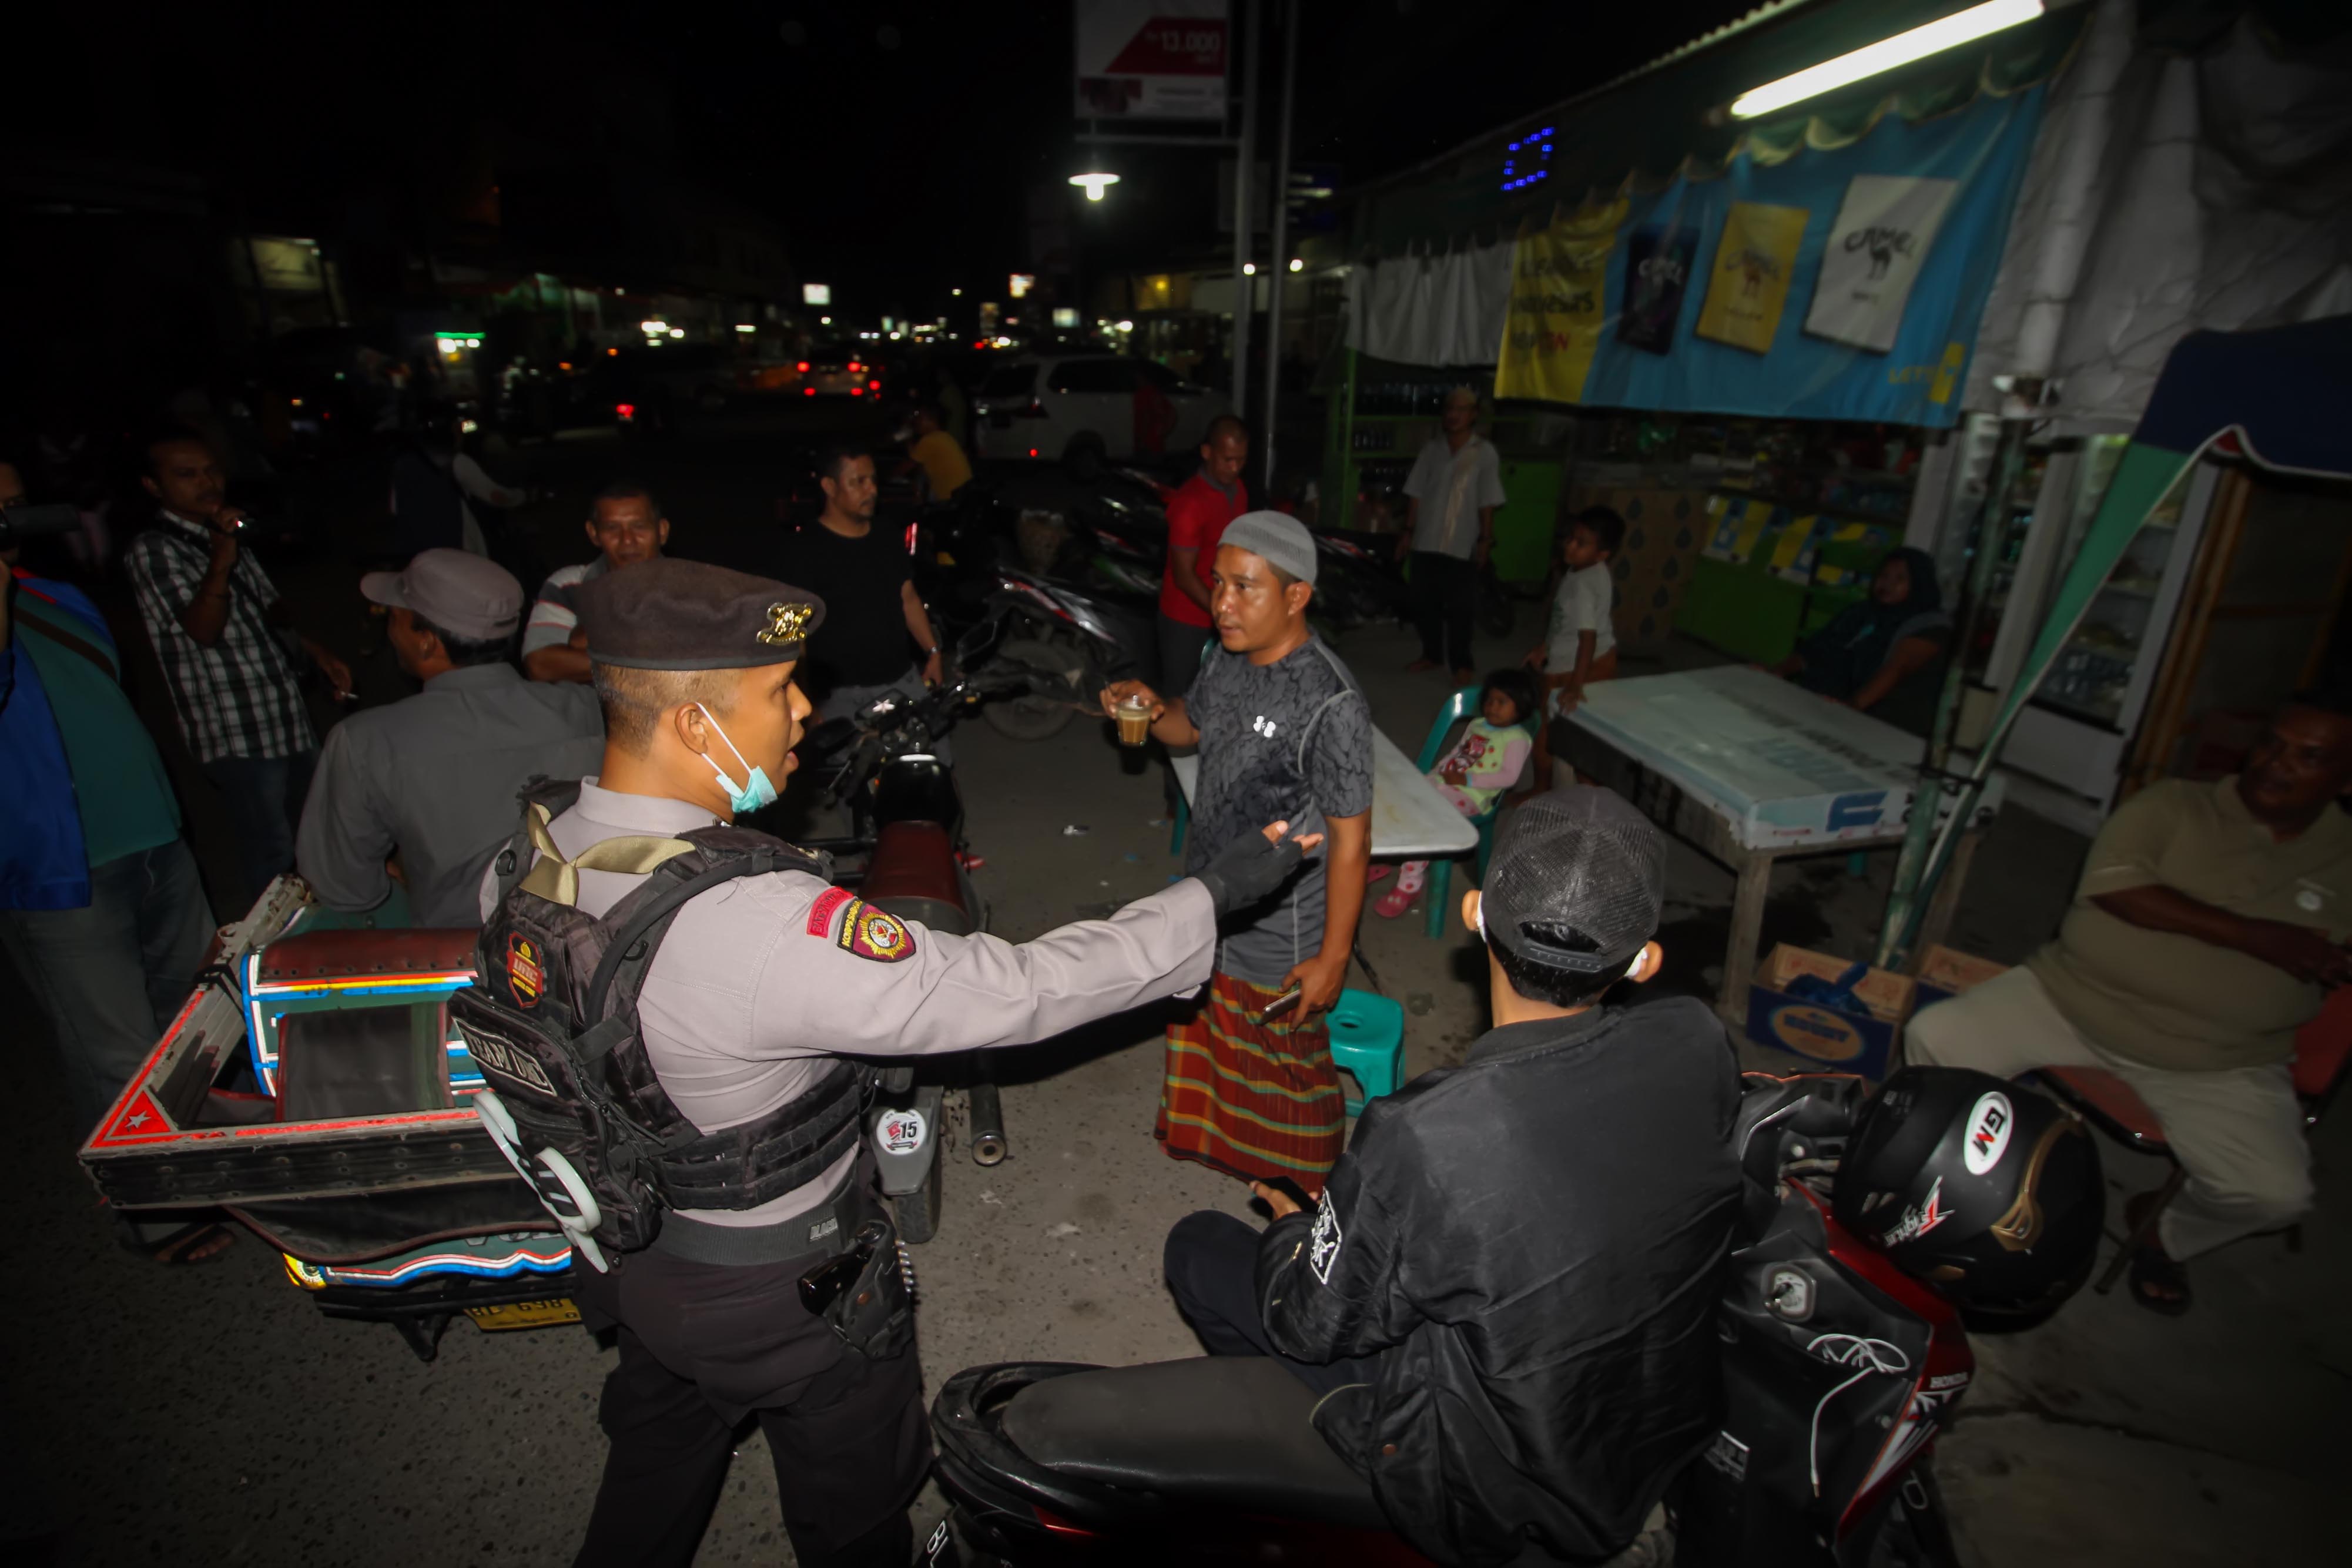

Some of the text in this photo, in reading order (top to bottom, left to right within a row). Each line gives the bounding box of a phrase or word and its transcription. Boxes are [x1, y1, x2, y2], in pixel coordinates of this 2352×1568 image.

[1844, 227, 1917, 258] CAMEL
[461, 1030, 512, 1071] TEAM
[900, 1121, 917, 1138] 15
[1973, 1106, 2005, 1157] GM
[1929, 1372, 1969, 1389] HONDA
